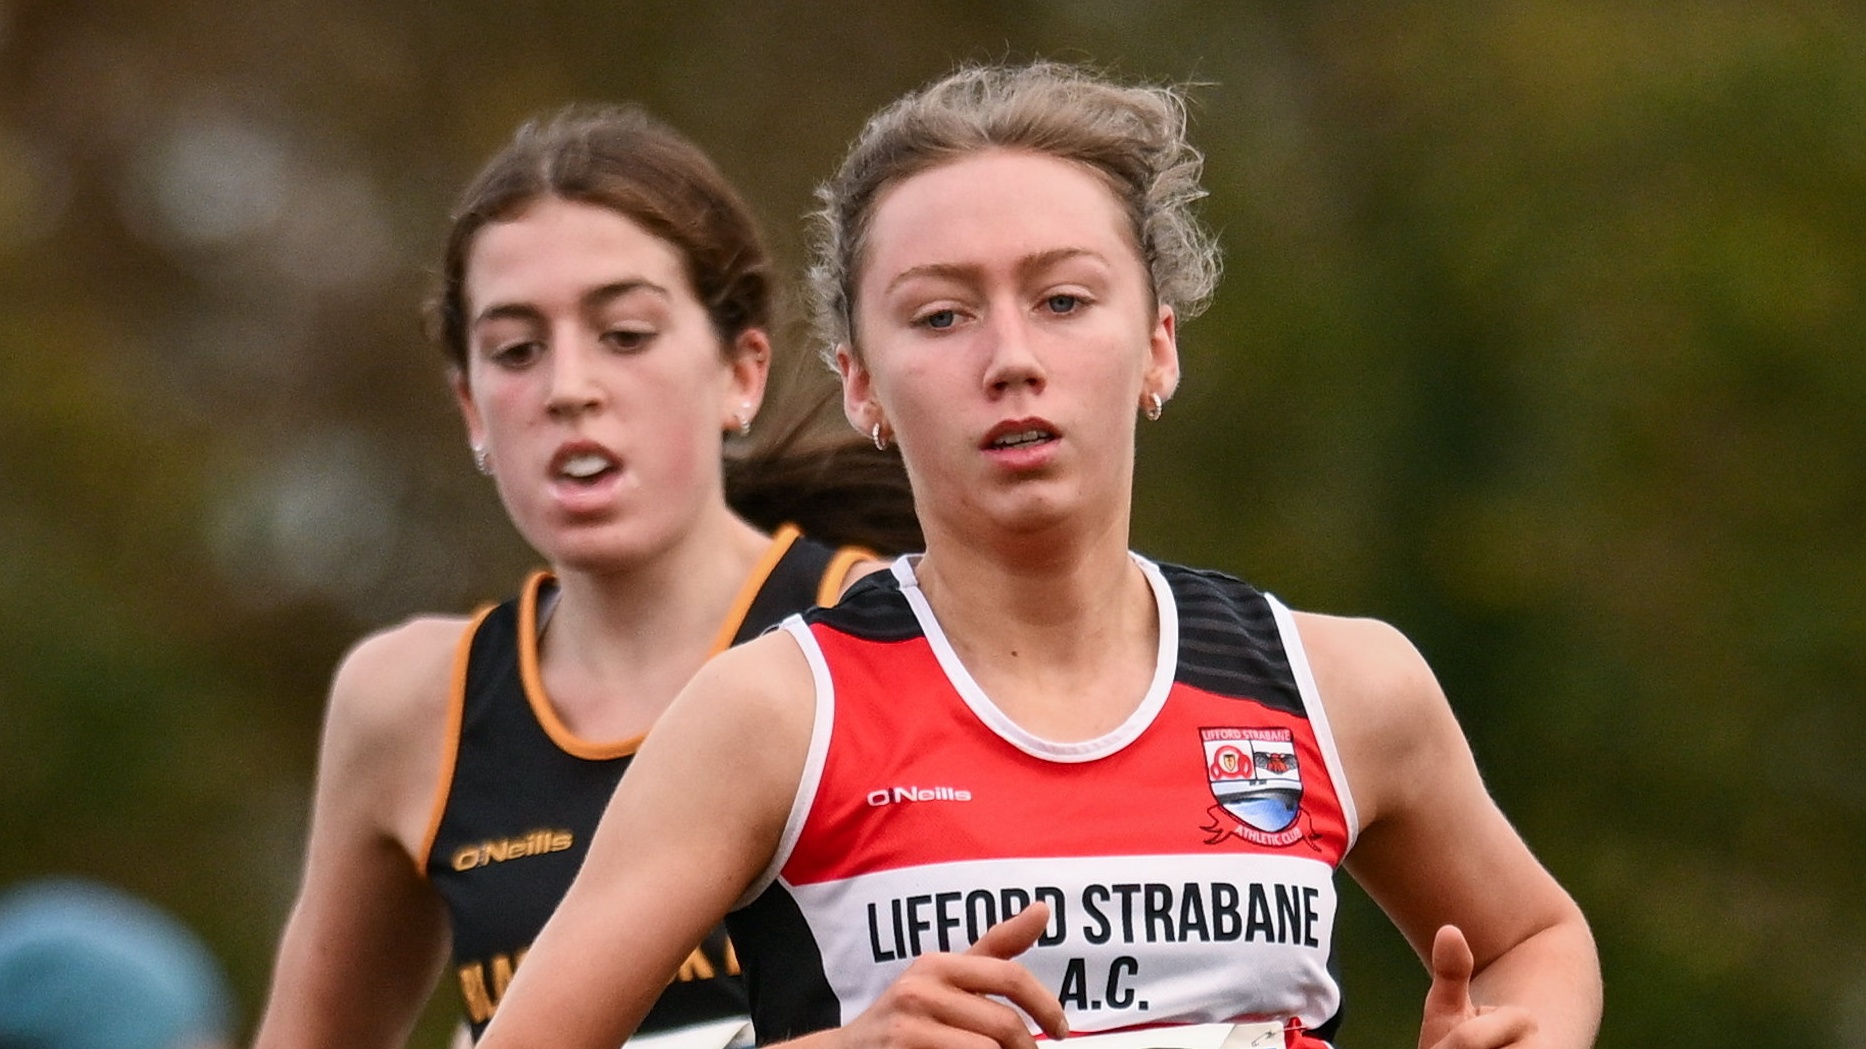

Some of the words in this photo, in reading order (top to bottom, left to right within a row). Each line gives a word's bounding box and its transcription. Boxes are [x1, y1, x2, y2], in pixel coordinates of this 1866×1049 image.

[1201, 728, 1241, 741] LIFFORD
[1242, 728, 1291, 741] STRABANE
[1234, 824, 1282, 846] ATHLETIC
[1081, 882, 1320, 948] STRABANE
[1058, 955, 1149, 1011] A.C.
